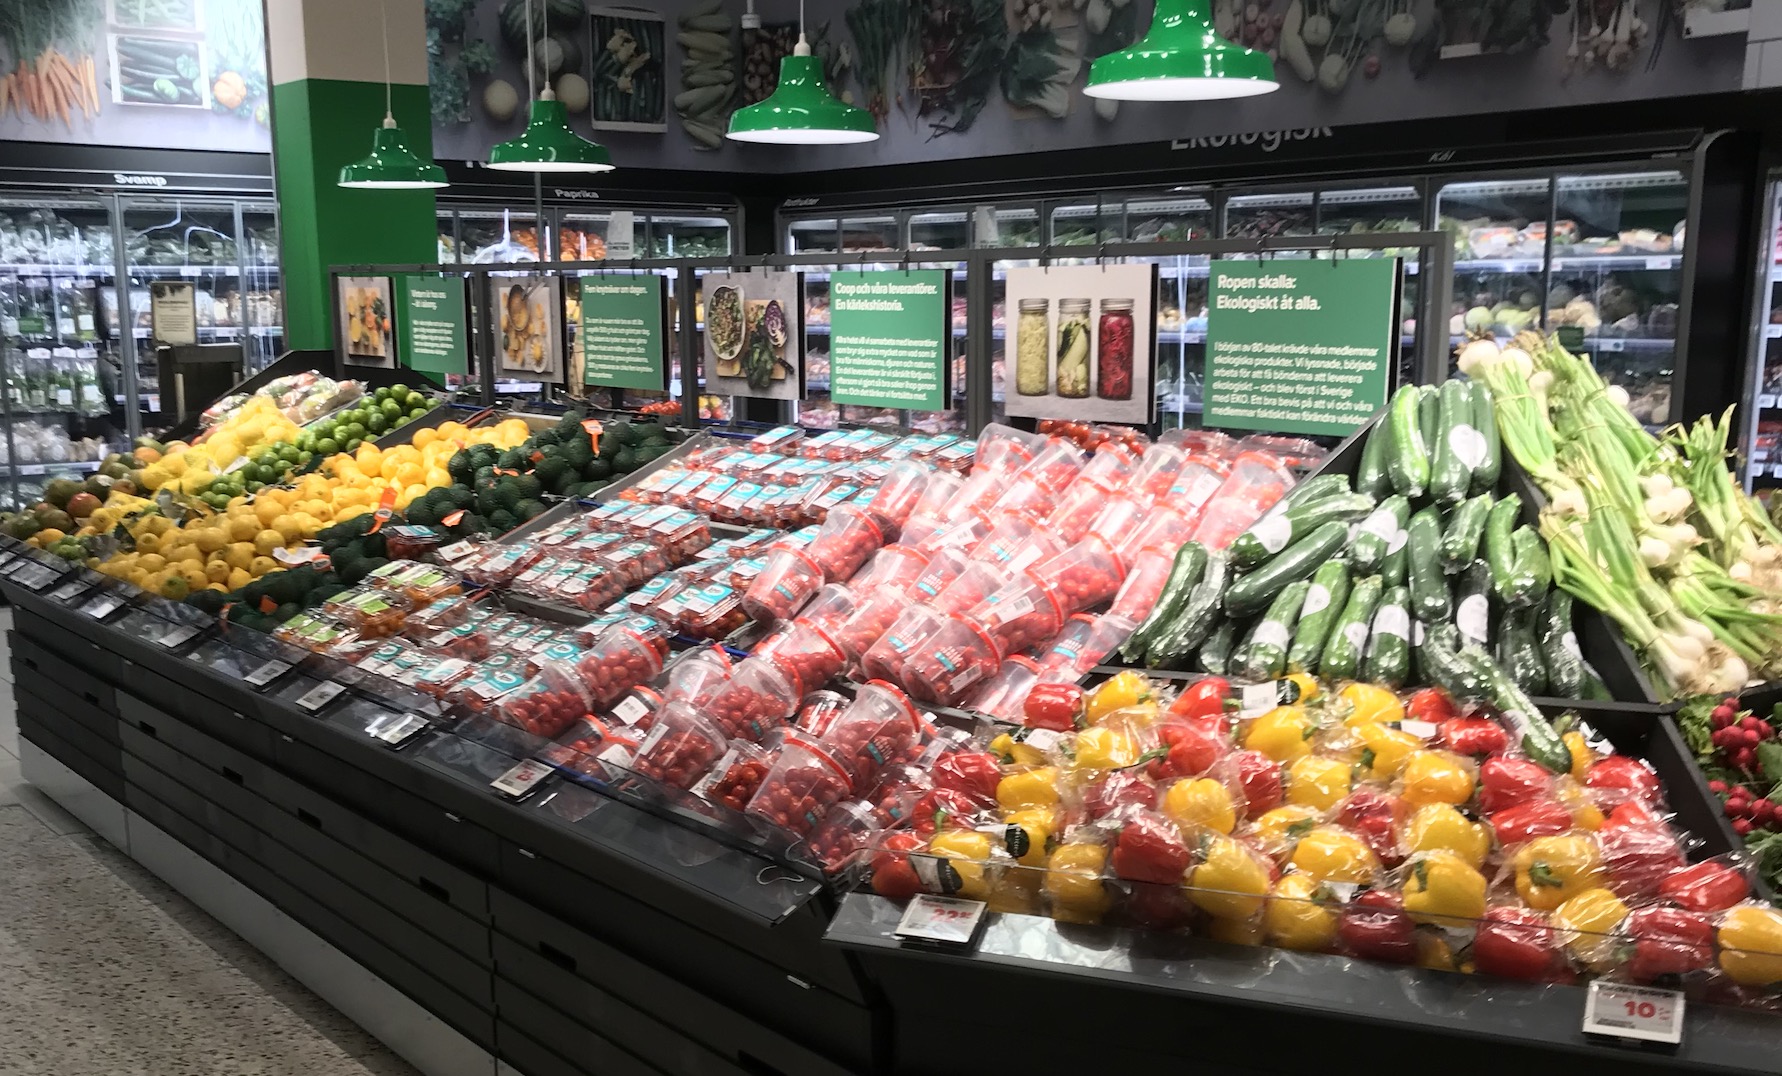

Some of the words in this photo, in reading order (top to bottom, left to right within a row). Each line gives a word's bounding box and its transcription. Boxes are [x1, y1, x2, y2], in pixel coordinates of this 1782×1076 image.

[113, 173, 167, 187] Svamp
[554, 188, 600, 200] Paprika
[835, 282, 855, 297] Coop
[856, 283, 870, 294] och
[871, 281, 888, 295] våra
[888, 282, 938, 295] leverantörer.
[1217, 274, 1255, 292] Ropen
[1258, 274, 1297, 289] skalla:
[835, 299, 846, 310] En
[846, 299, 905, 311] kärlekshistoria.
[1216, 294, 1278, 313] Ekologiskt
[1280, 293, 1293, 310] åt
[1295, 295, 1321, 311] alla.
[1217, 341, 1241, 354] början
[1251, 342, 1281, 352] 80-talet
[1282, 344, 1308, 354] krävde
[1310, 345, 1326, 354] våra
[1327, 346, 1377, 356] medlemmar
[1213, 355, 1253, 367] ekologiska
[1254, 357, 1293, 367] produkter.
[1294, 358, 1302, 367] Vi
[1303, 359, 1342, 370] lyssnade,
[1343, 361, 1376, 372] började
[1213, 367, 1238, 377] arbeta
[1239, 368, 1250, 378] för
[1251, 369, 1262, 378] att
[1263, 370, 1272, 379] få
[1273, 371, 1312, 380] bönderna
[1313, 373, 1326, 382] att
[1327, 374, 1363, 383] leverera
[1212, 381, 1252, 392] ekologiskt
[1260, 383, 1275, 392] och
[1276, 383, 1294, 393] blev
[1295, 384, 1314, 394] först
[1320, 386, 1353, 400] Sverige
[1211, 394, 1229, 402] med
[1230, 393, 1249, 403] EKO.
[1250, 394, 1262, 404] Ett
[1263, 396, 1277, 405] bra
[1278, 397, 1299, 407] bevis
[1300, 398, 1311, 410] på
[1313, 399, 1325, 409] att
[1326, 400, 1334, 409] vi
[1335, 401, 1352, 410] och
[1353, 402, 1373, 412] våra
[1211, 406, 1255, 416] medlemmar
[1286, 410, 1300, 420] kan
[1301, 411, 1336, 423] förändra
[1624, 1000, 1656, 1018] 10
